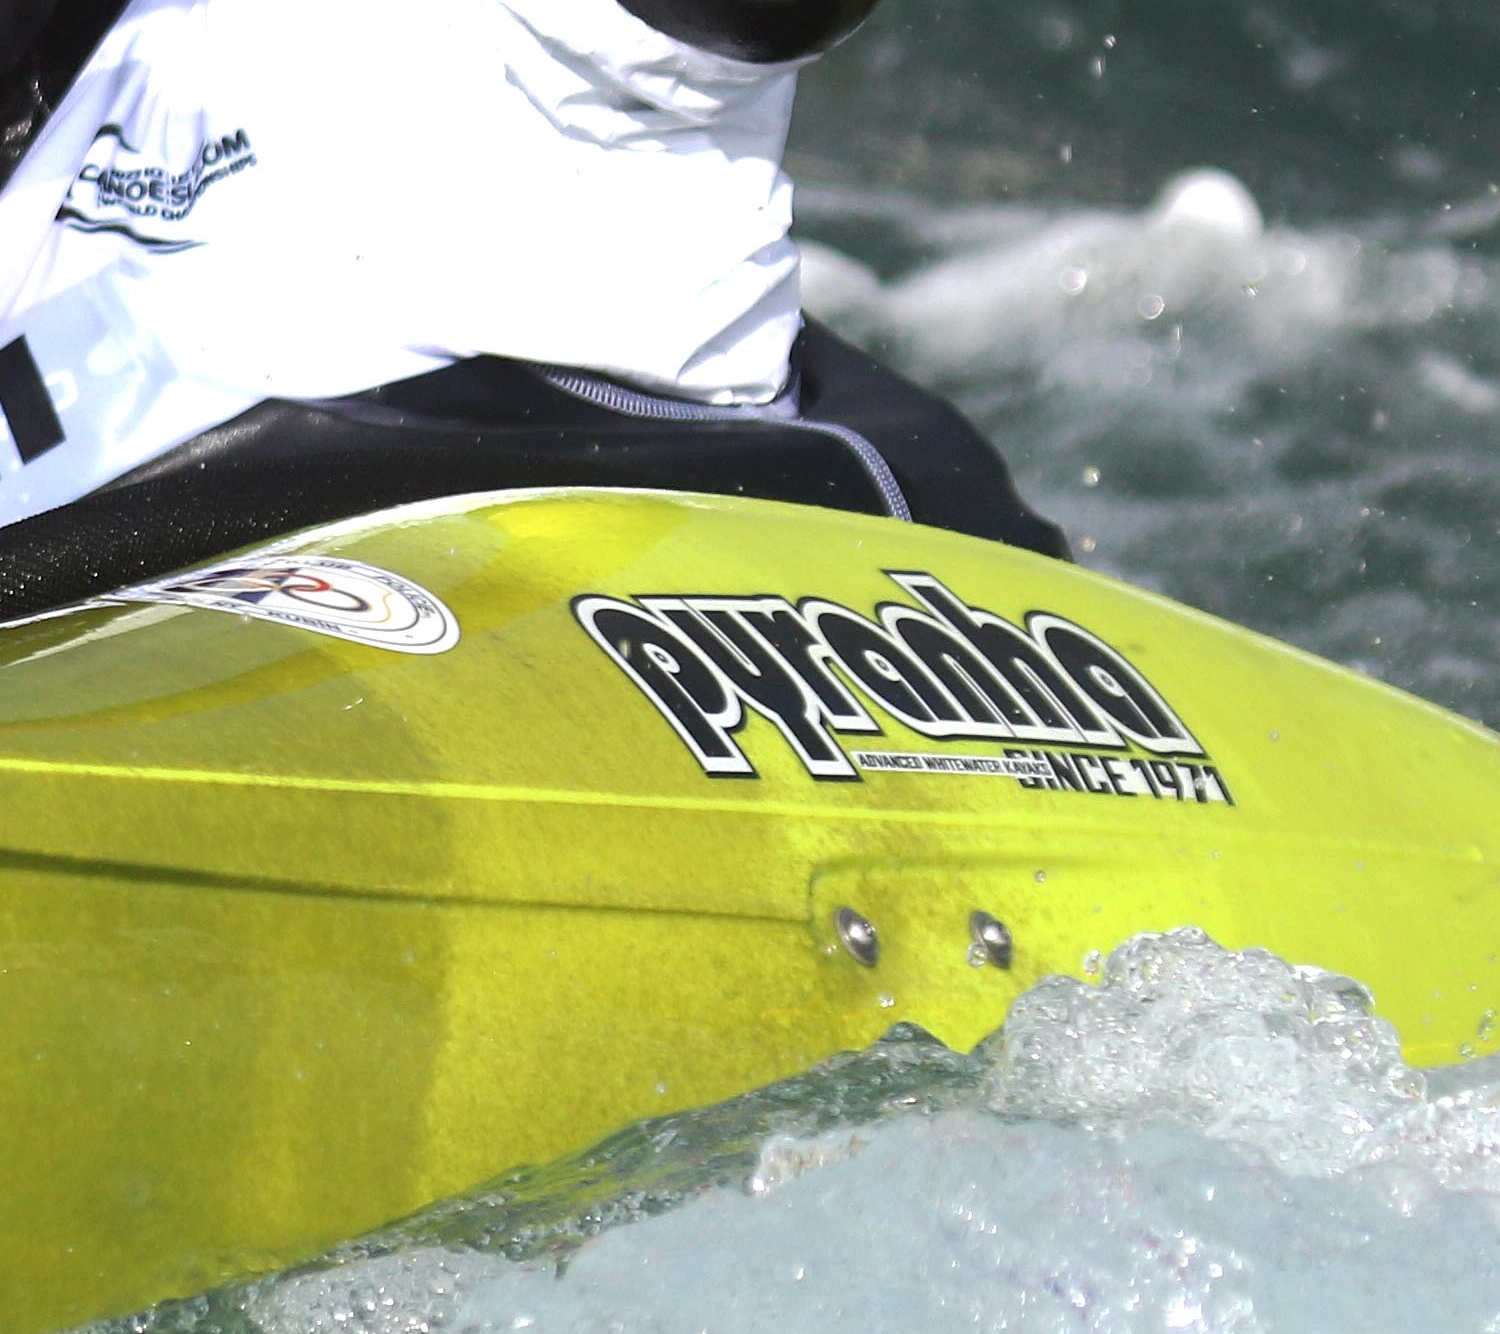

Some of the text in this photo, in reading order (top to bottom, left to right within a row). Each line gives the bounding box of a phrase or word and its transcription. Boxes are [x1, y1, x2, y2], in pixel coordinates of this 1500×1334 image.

[858, 753, 1053, 777] ADVANCED WHITEWATER KAYAKS
[1003, 749, 1236, 806] SINCE 1971
